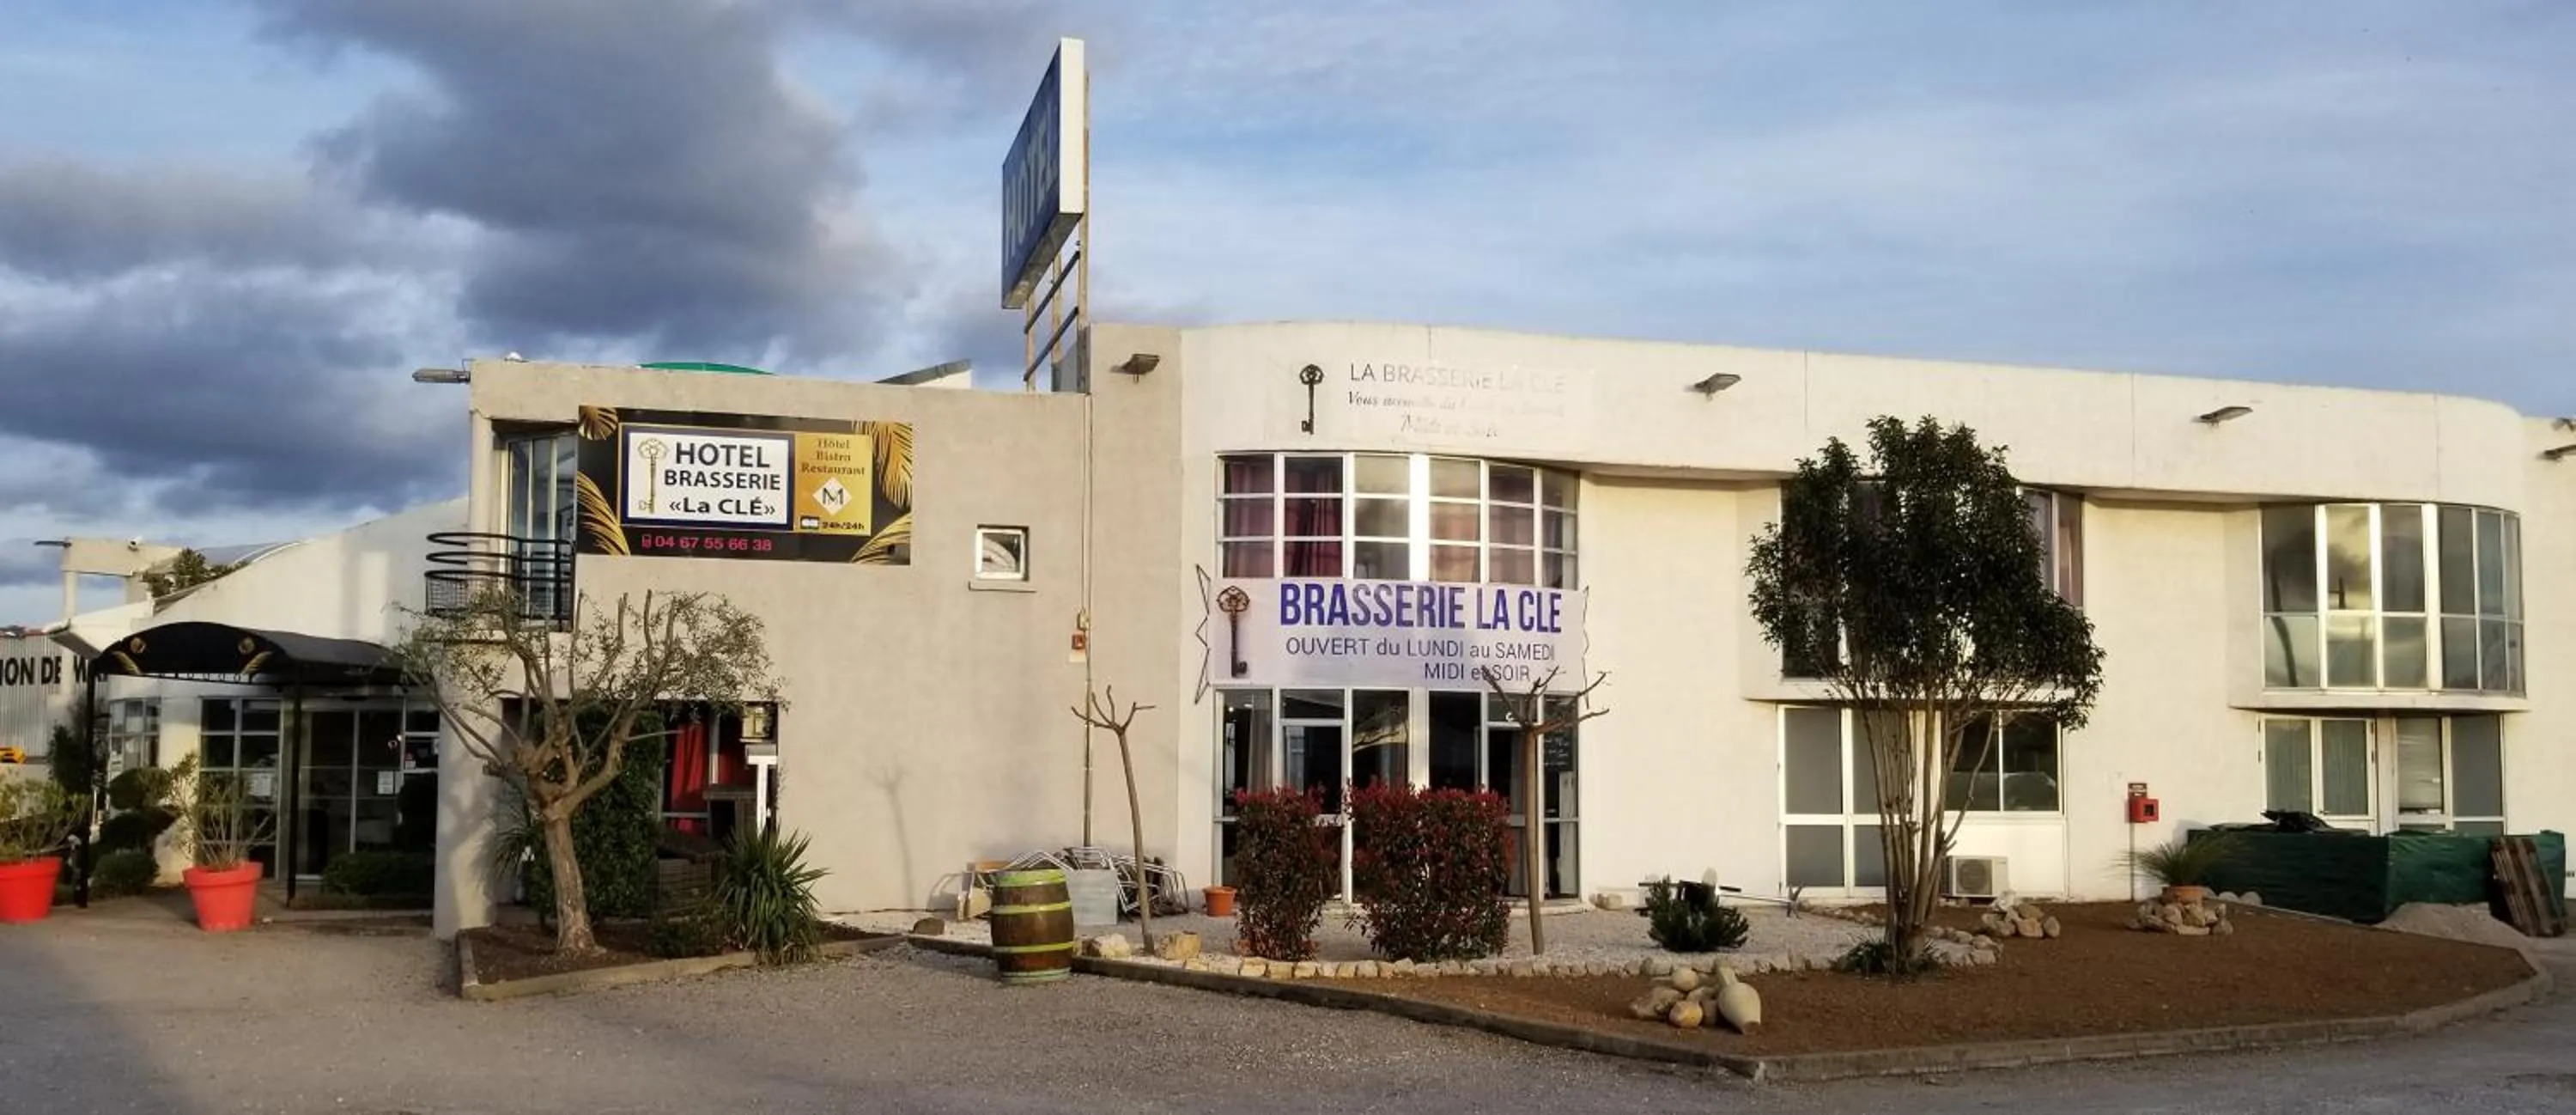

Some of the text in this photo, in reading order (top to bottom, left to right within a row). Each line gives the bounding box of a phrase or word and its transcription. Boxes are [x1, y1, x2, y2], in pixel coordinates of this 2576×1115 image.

[1350, 363, 1375, 382] LA
[1382, 363, 1492, 390] BRASSERIE
[676, 442, 771, 468] HOTEL
[816, 449, 852, 462] Bistro
[800, 461, 866, 475] Restaurant
[664, 469, 781, 490] BRASSERIE
[654, 534, 773, 551] 04 67 55 66 38
[1279, 582, 1562, 633] BRASSERIE LA CLE
[1286, 637, 1555, 661] OUVERT du LUNDI au SAMEDI
[1425, 662, 1464, 679] MIDI
[1491, 664, 1530, 682] SOIR
